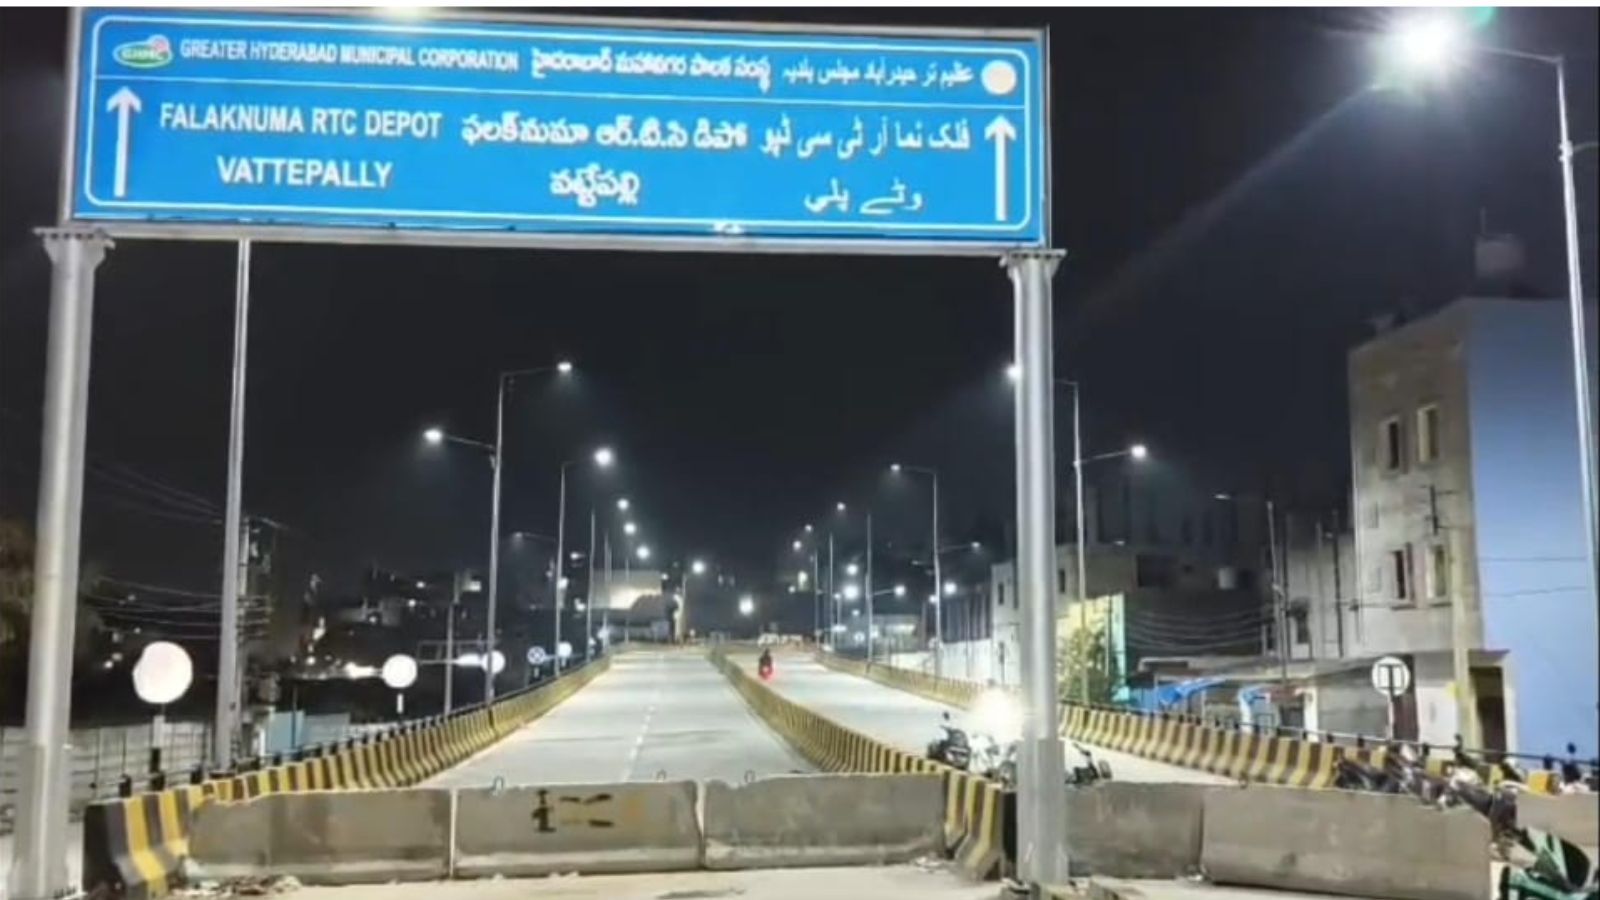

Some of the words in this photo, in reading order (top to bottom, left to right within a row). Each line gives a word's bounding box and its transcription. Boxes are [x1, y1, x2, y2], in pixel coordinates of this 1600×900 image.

[180, 39, 247, 60] GREATER
[249, 42, 337, 64] HYDERABAD
[339, 45, 415, 67] MUNICIPAL
[418, 48, 519, 72] CORPORATION
[160, 103, 304, 133] FALAKNUMA
[311, 108, 357, 135] RTC
[364, 109, 441, 139] DEPOT
[693, 118, 749, 150] డిపో
[928, 117, 971, 150] فلک
[217, 155, 392, 189] VATTEPALLY
